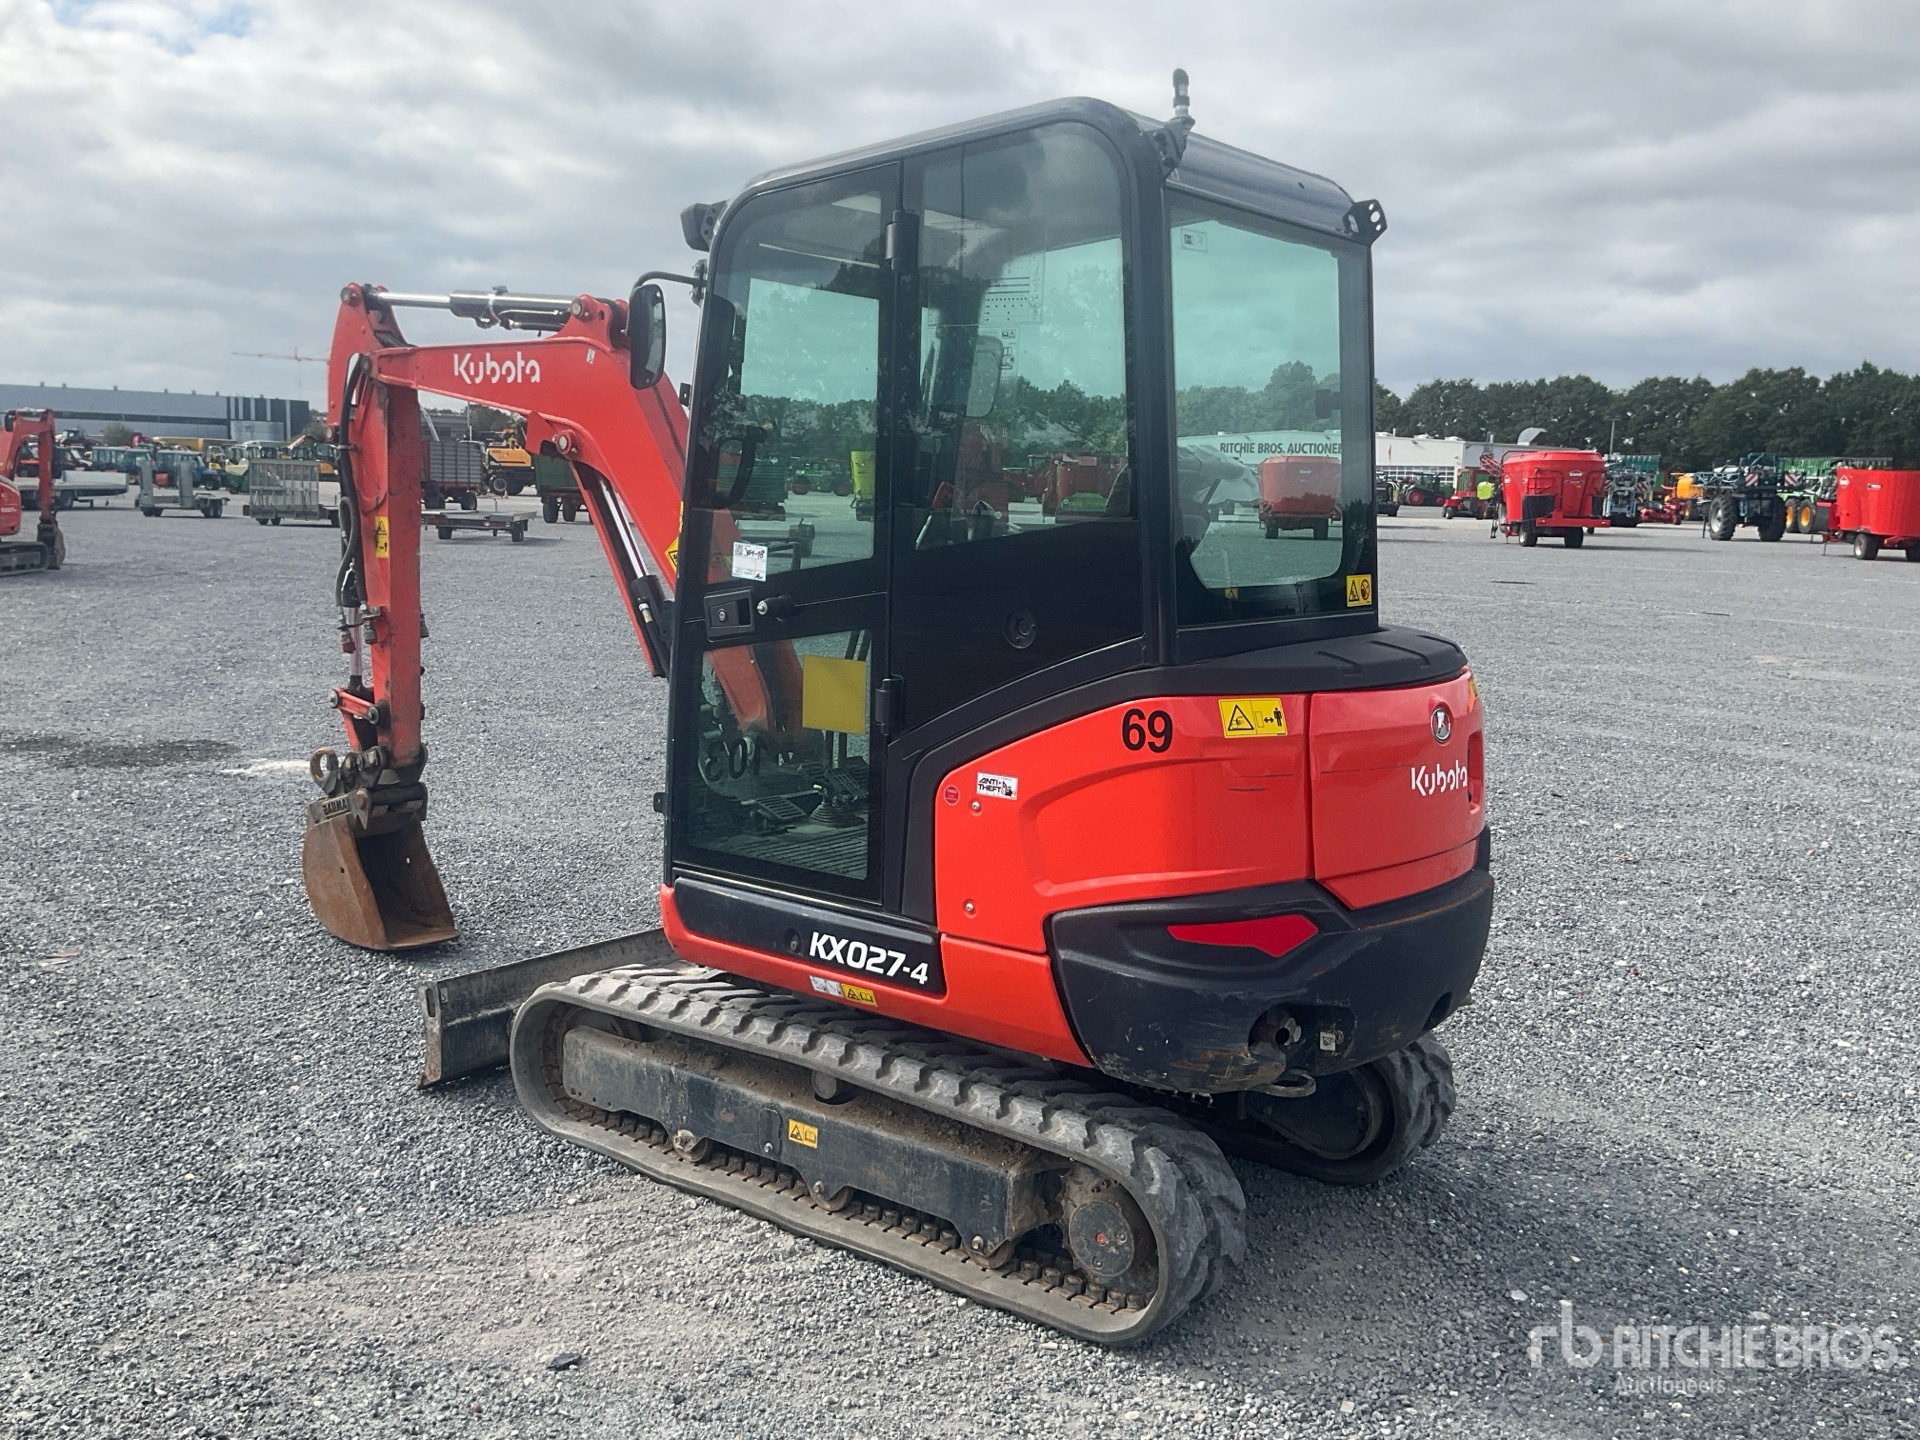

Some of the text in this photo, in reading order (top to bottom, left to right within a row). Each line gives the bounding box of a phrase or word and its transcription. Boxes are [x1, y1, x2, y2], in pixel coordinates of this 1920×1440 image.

[453, 351, 541, 384] Kubota
[1220, 442, 1255, 454] RITCHIE
[1257, 442, 1285, 454] BROS.
[1122, 708, 1173, 754] 69
[978, 783, 1002, 793] THEFT
[979, 777, 999, 785] ANTI
[1411, 759, 1468, 796] Kubota
[809, 931, 929, 985] KX027-4
